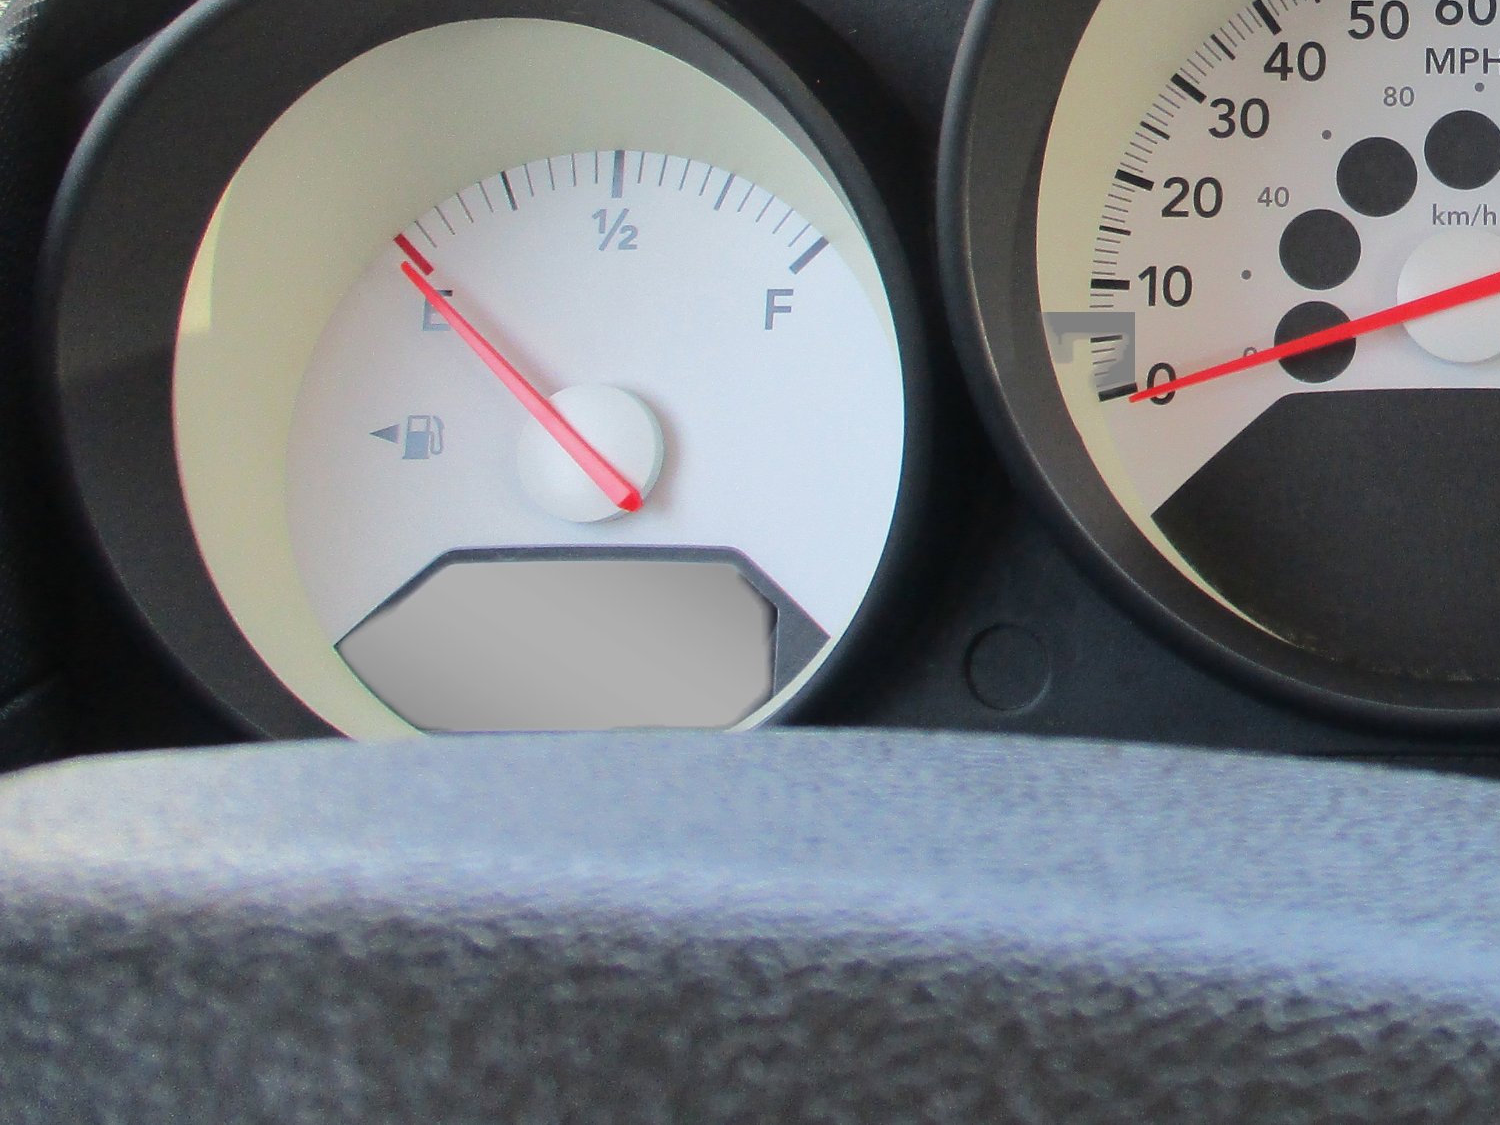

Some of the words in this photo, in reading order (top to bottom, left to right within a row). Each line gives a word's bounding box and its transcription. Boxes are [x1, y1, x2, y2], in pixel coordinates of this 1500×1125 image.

[1347, 0, 1410, 40] 50
[1263, 41, 1327, 82] 40
[1383, 86, 1415, 107] 80
[1208, 97, 1270, 139] 30
[1161, 176, 1223, 219] 20
[1257, 186, 1290, 208] 40
[1432, 203, 1498, 227] km/h
[1138, 265, 1193, 308] 10
[422, 288, 454, 331] E
[764, 288, 795, 331] F
[1146, 362, 1177, 406] 0
